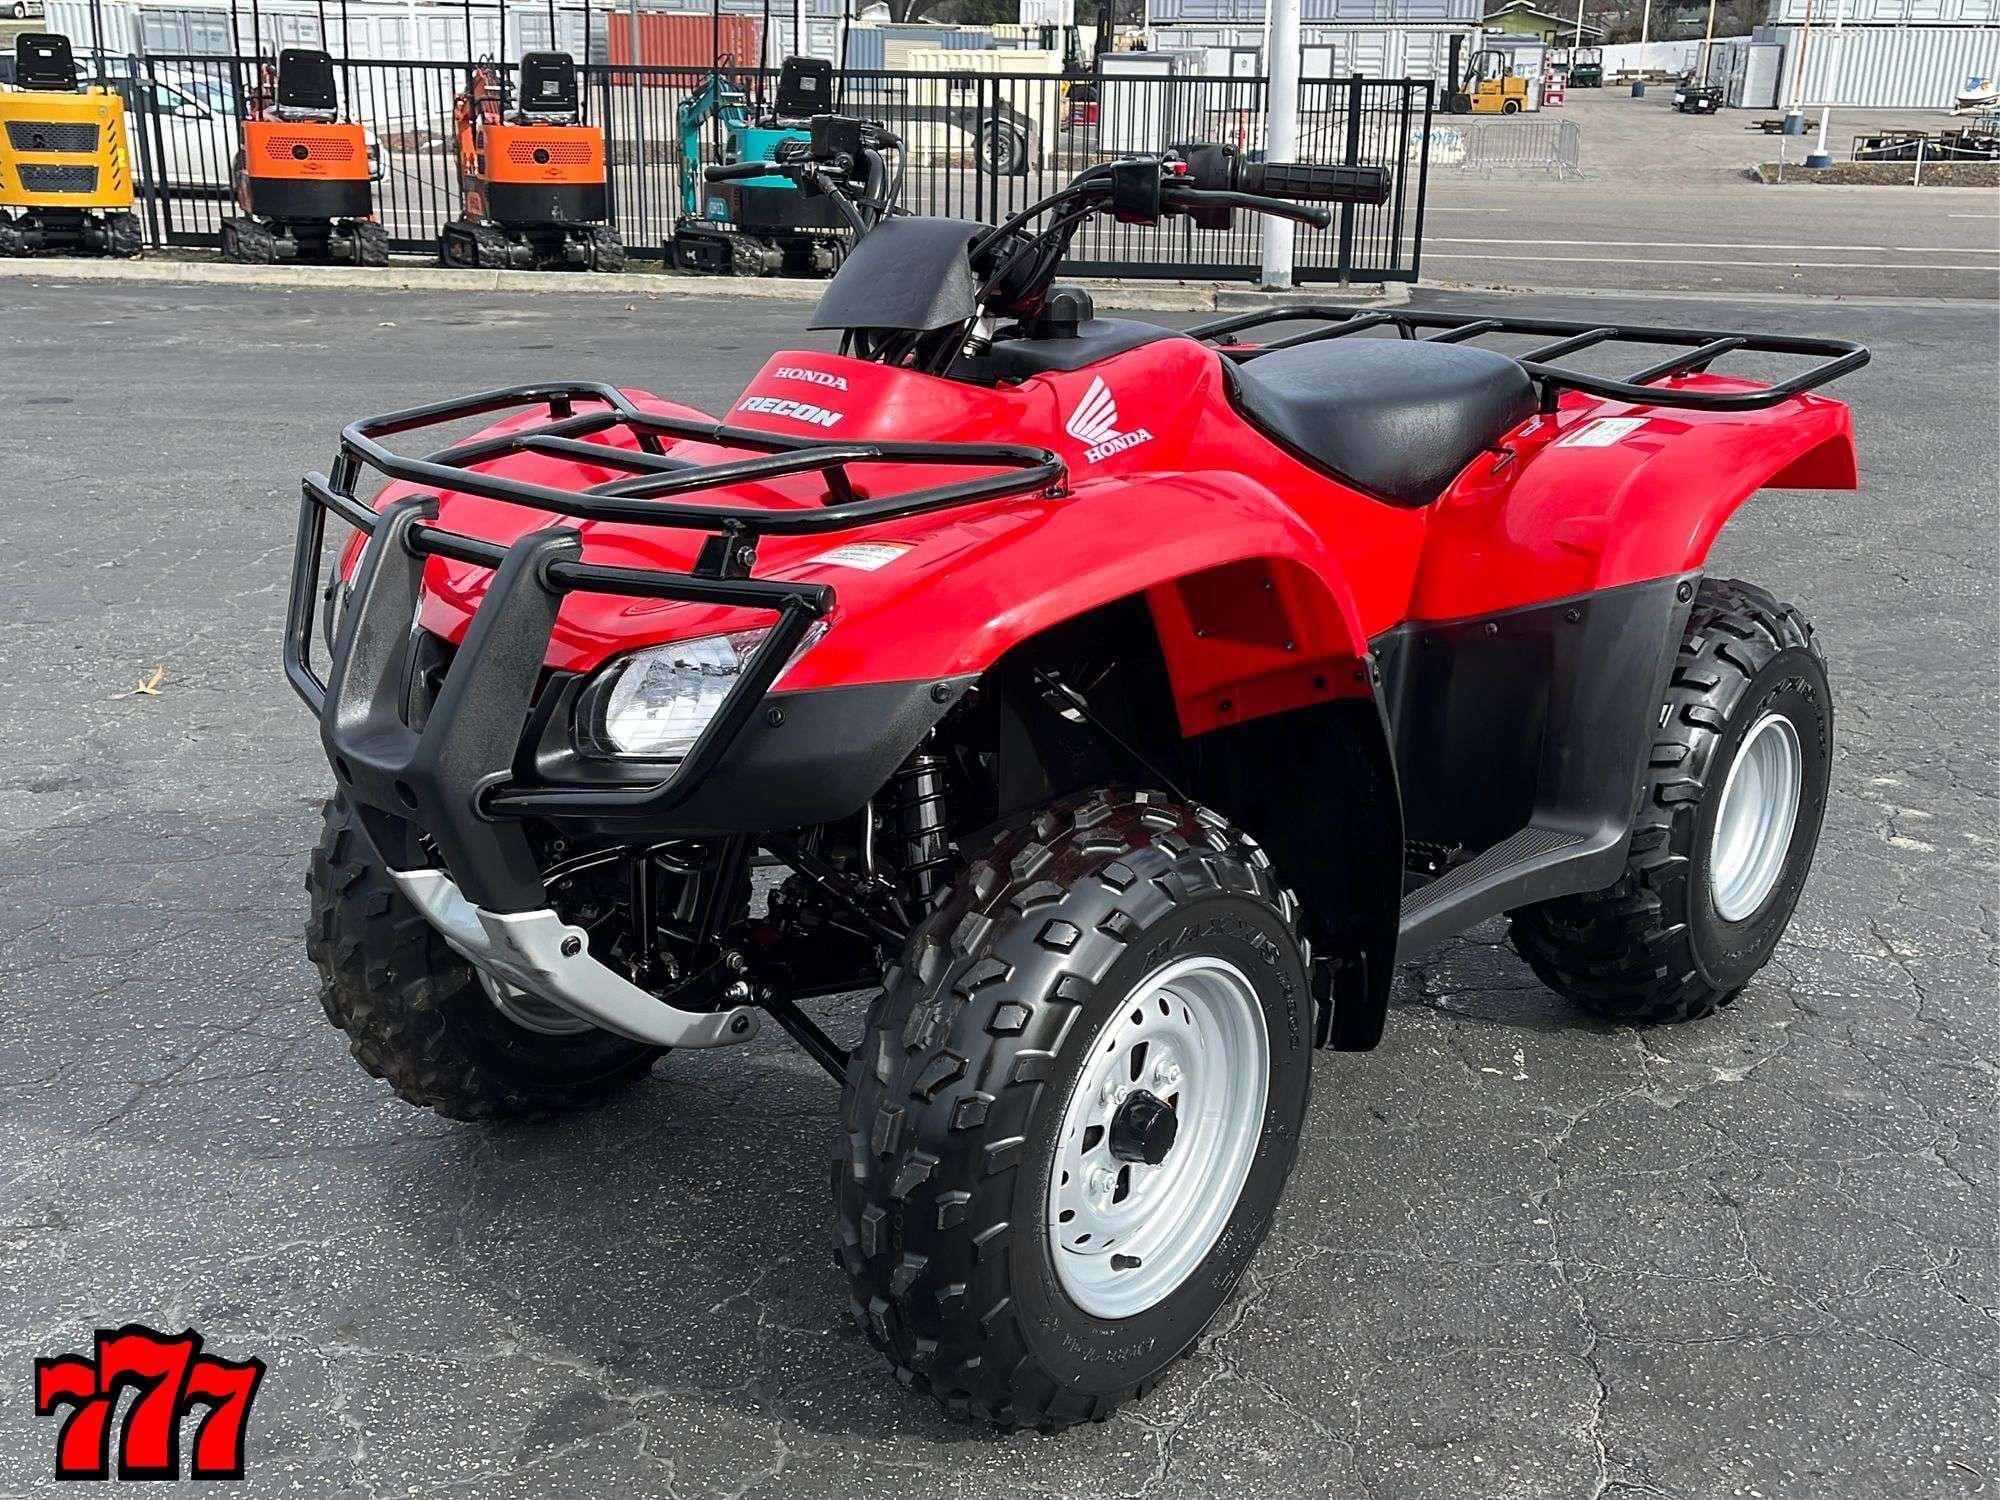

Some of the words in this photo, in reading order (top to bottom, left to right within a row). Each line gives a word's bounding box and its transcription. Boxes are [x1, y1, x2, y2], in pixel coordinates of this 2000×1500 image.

[774, 367, 848, 391] HONDA
[738, 396, 843, 428] RECON
[1084, 428, 1153, 463] HONDA
